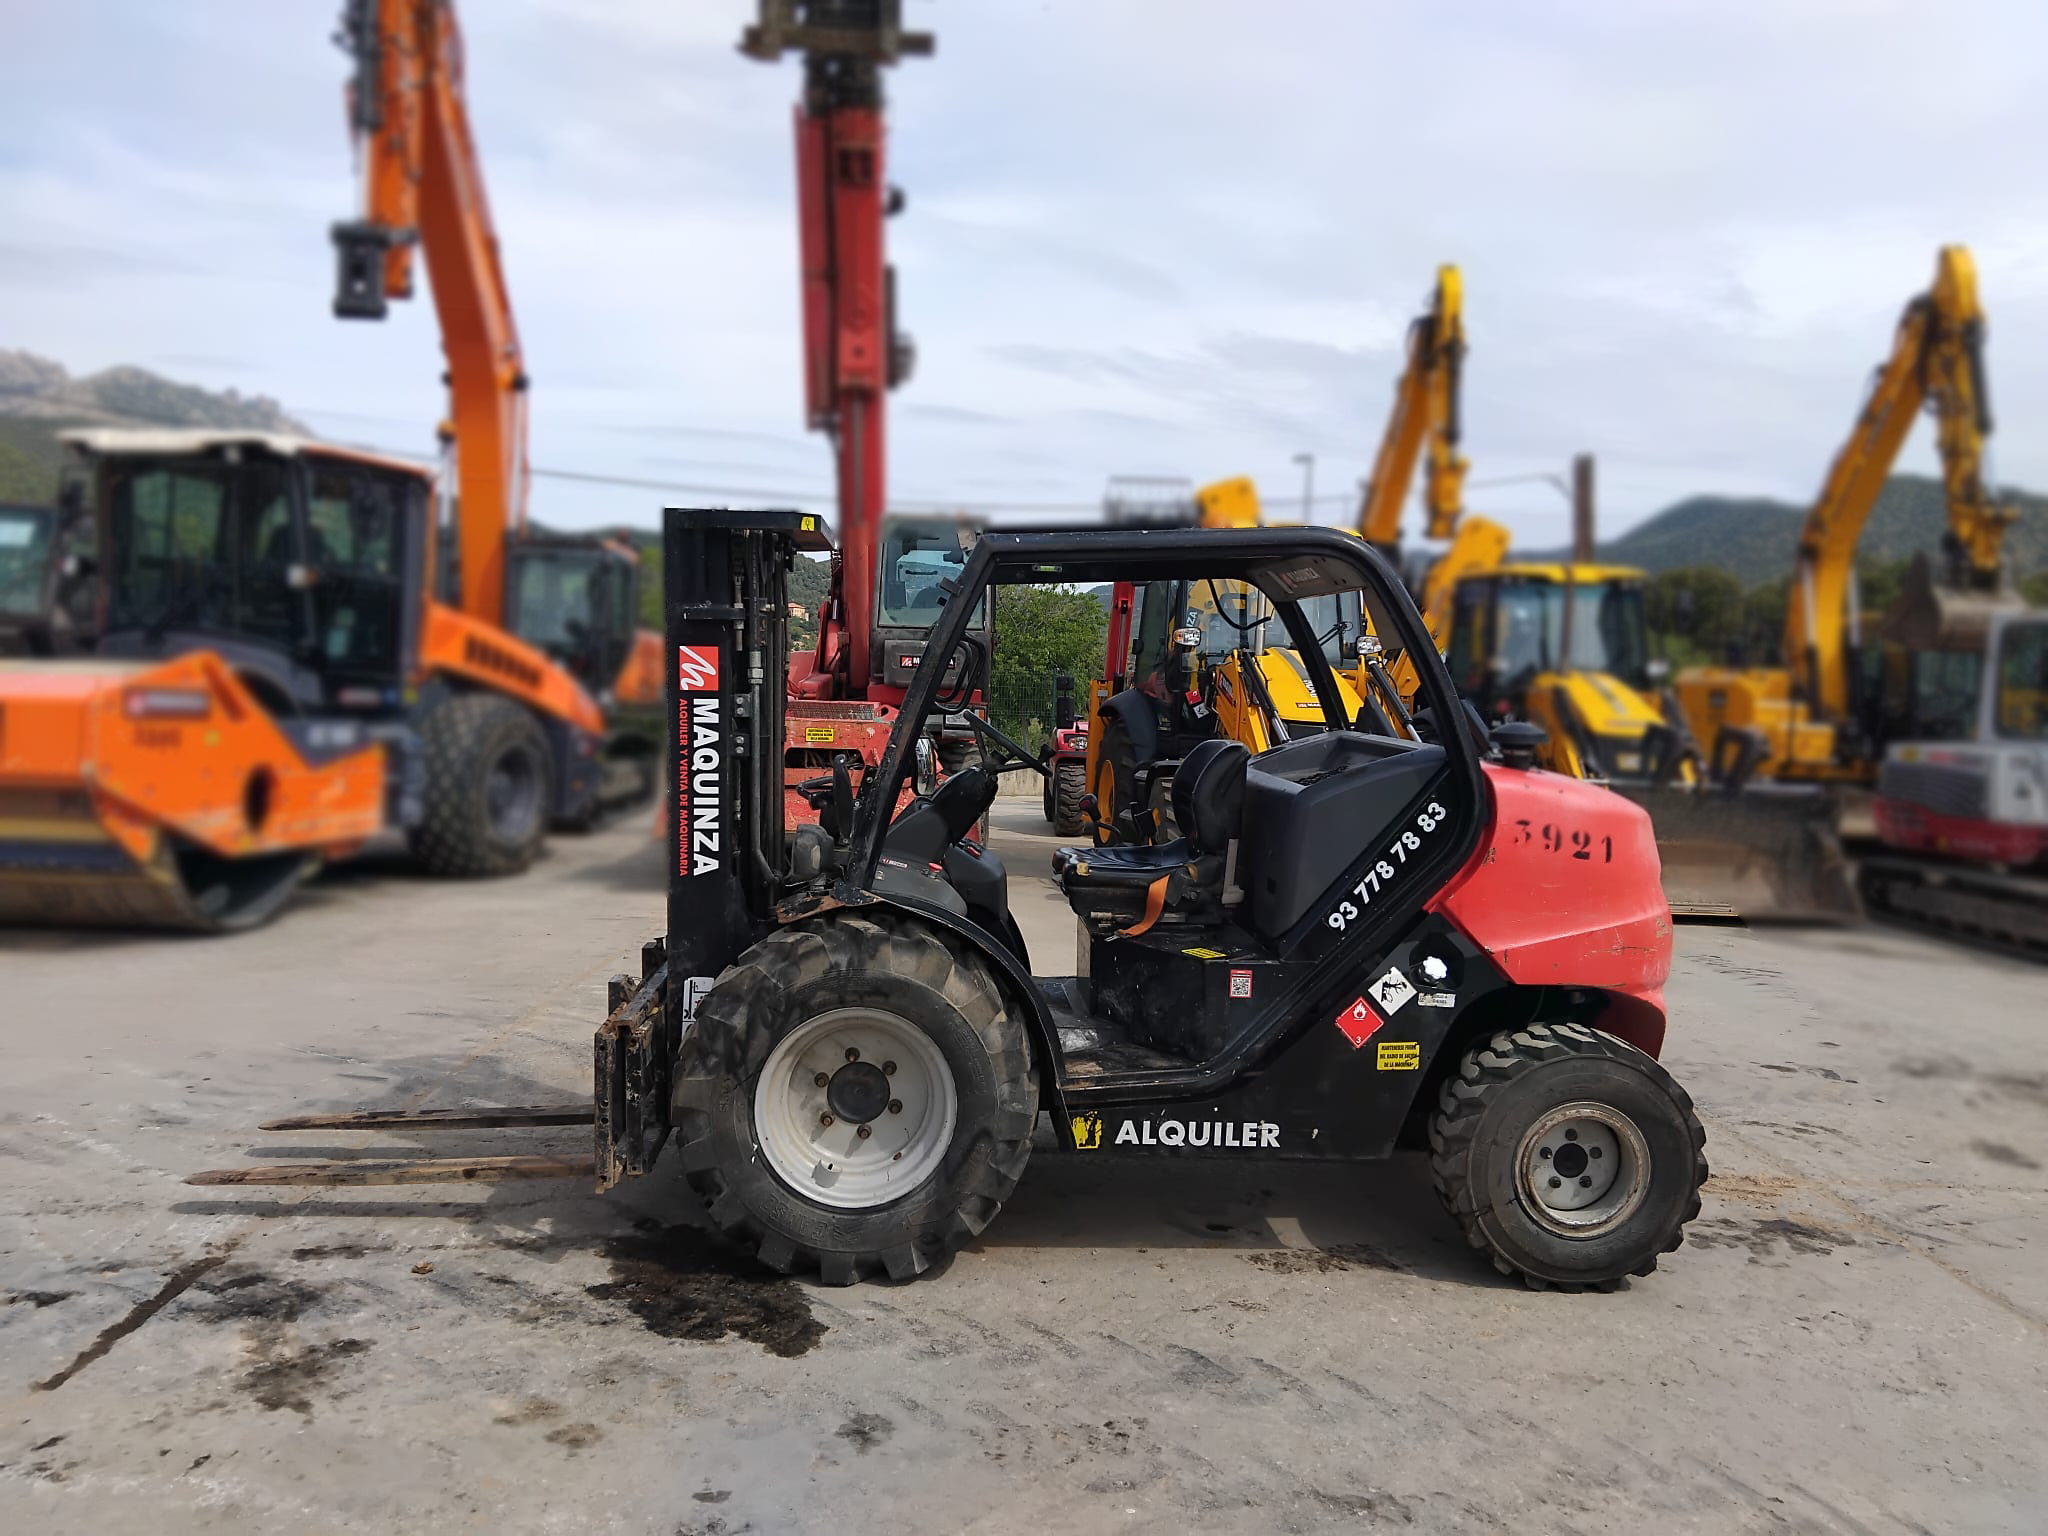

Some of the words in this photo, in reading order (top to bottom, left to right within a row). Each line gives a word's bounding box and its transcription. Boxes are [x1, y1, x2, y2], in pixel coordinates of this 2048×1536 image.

[680, 699, 688, 745] ALQUILER
[680, 758, 688, 791] VENTA
[691, 698, 720, 876] MAQUINZA
[680, 794, 688, 806] DE
[680, 810, 688, 876] MAQUINARIA
[1328, 901, 1358, 931] 93
[1353, 860, 1395, 904] 778
[1389, 831, 1421, 863] 78
[1417, 802, 1447, 832] 83
[1355, 1036, 1362, 1044] 3
[1114, 1119, 1281, 1148] ALQUILER
